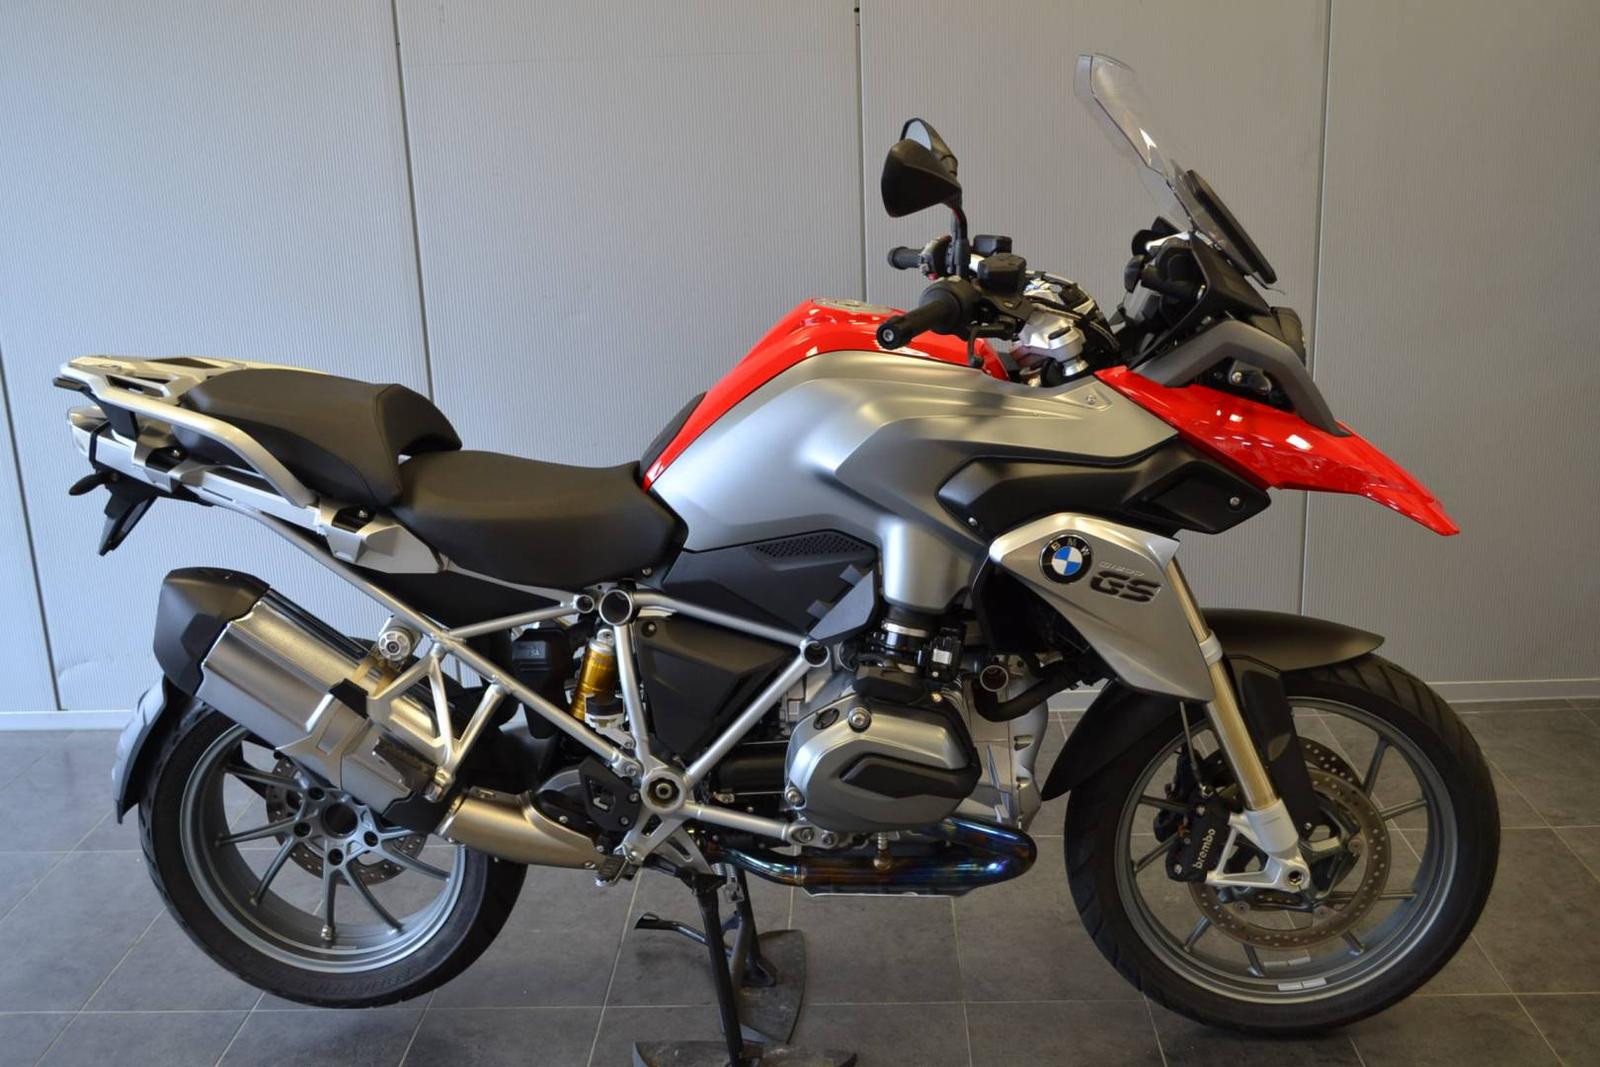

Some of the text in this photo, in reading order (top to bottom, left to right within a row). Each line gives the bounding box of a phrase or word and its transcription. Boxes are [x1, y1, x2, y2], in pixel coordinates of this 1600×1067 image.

[1051, 538, 1090, 556] BMW
[1090, 570, 1161, 602] GS
[1192, 828, 1216, 869] brembo
